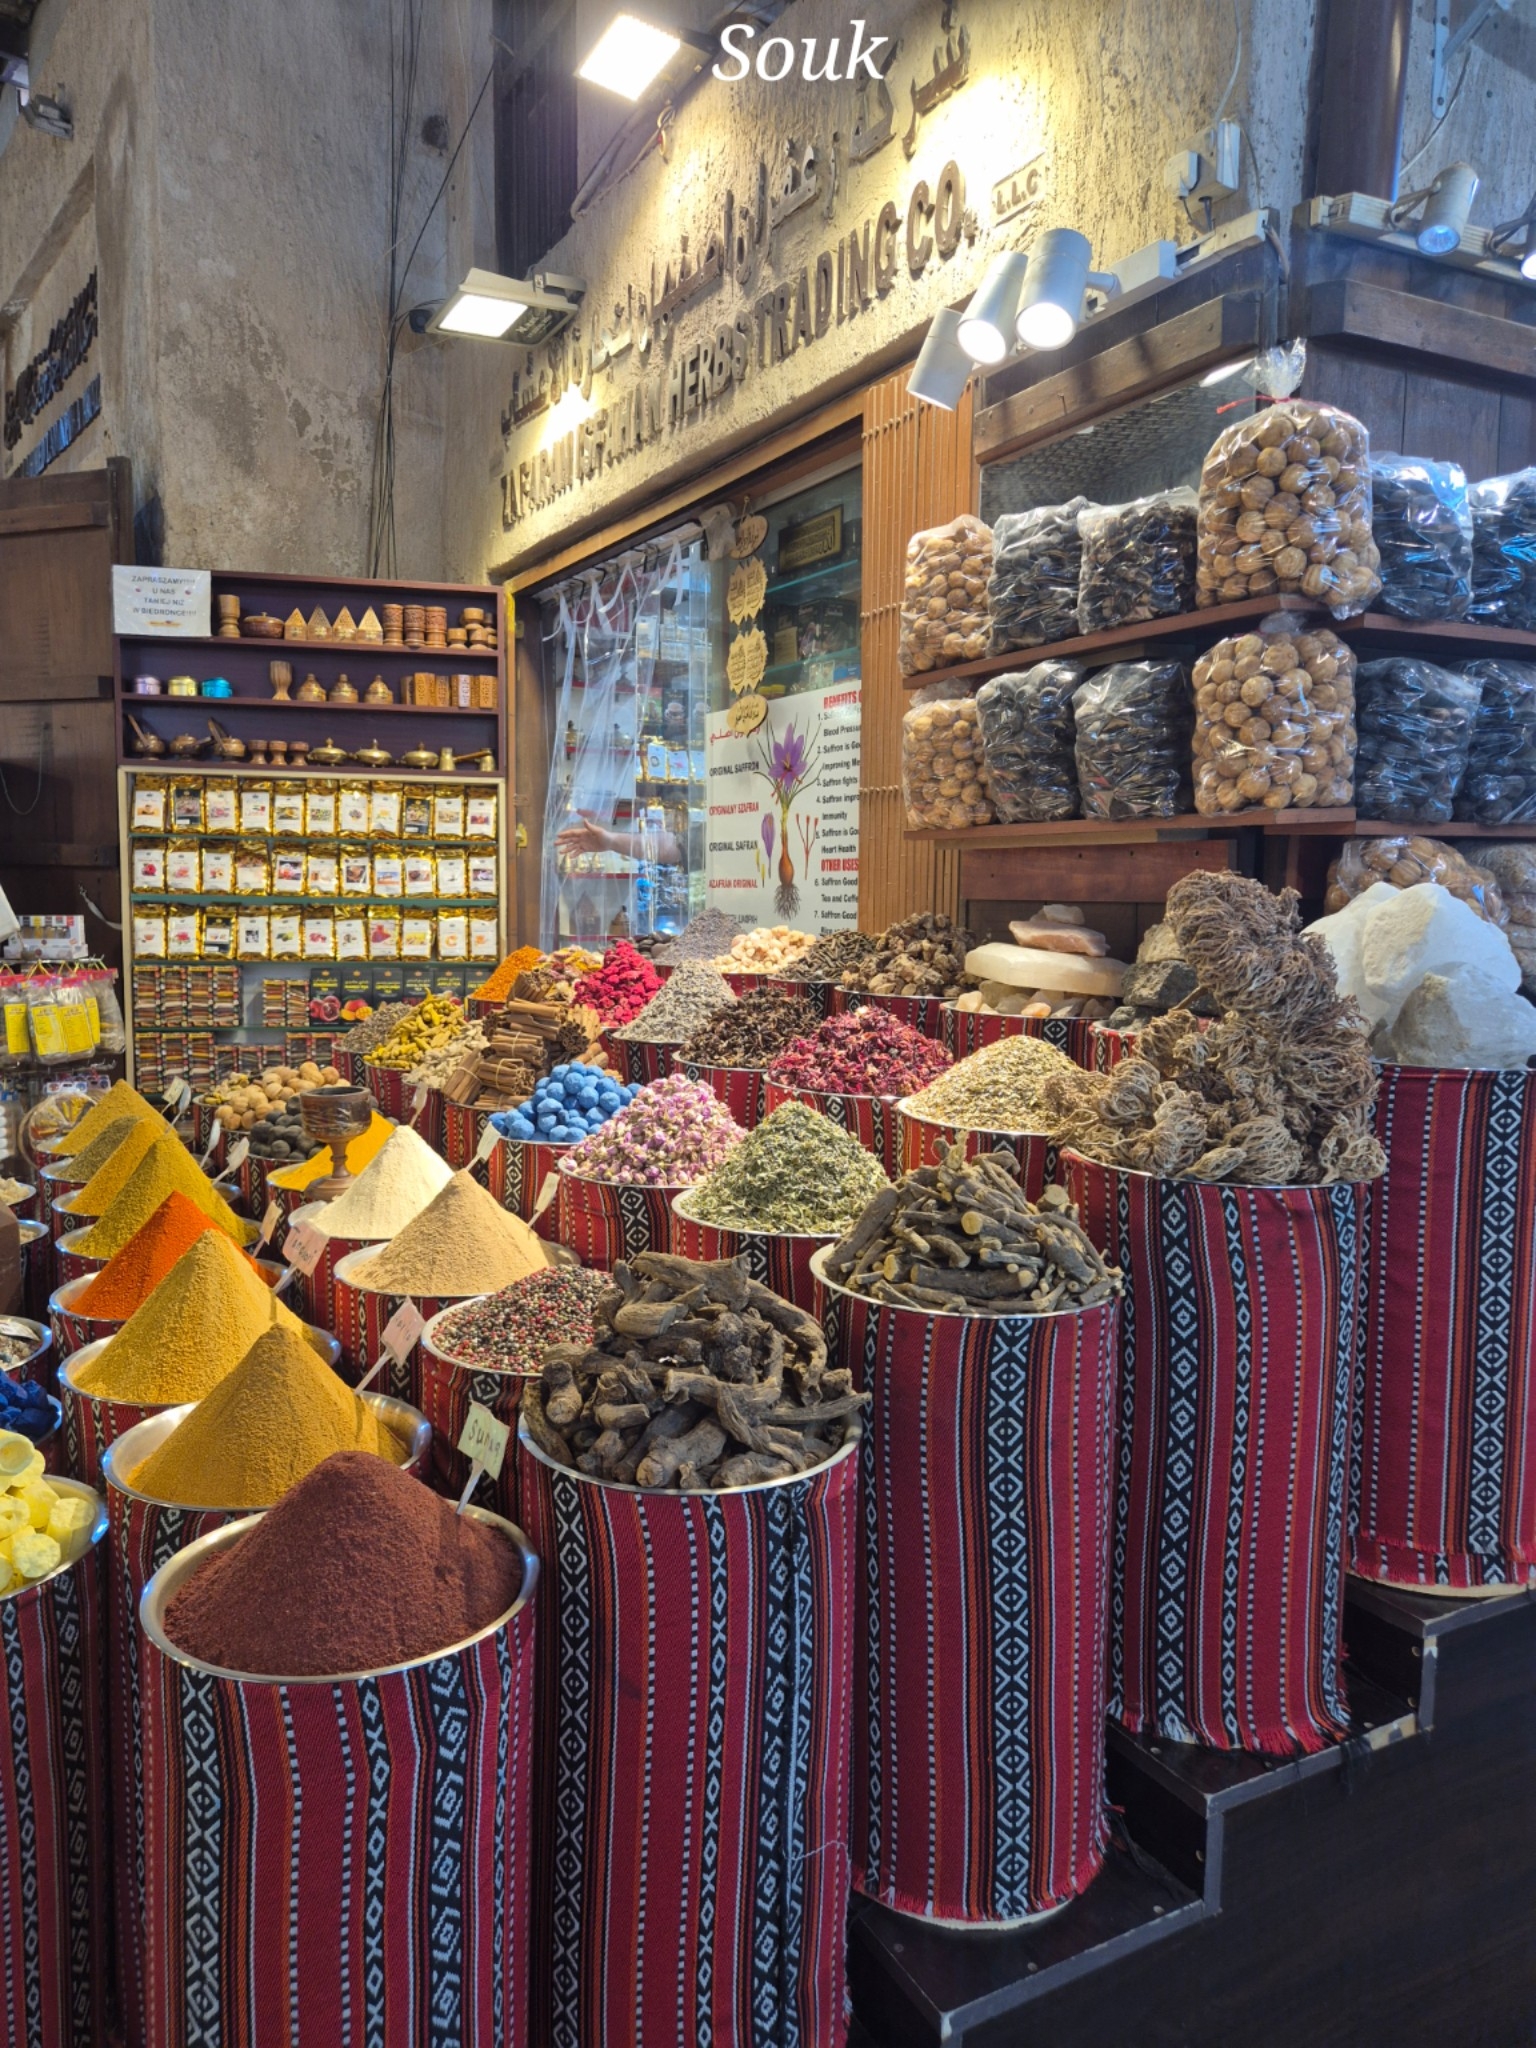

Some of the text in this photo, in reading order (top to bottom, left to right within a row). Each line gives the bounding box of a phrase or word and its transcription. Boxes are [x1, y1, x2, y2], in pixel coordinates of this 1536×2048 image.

[667, 310, 753, 424] HERBS
[754, 201, 899, 370] TRADING
[907, 160, 976, 273] CO.
[823, 691, 857, 709] BENEFITS
[709, 761, 759, 777] ORIGINAL SAFFRON
[823, 778, 841, 787] Saffron
[842, 776, 857, 787] fights
[822, 794, 842, 804] Saffron
[822, 811, 847, 820] Immunity
[822, 828, 841, 837] Saffron
[709, 841, 734, 852] ORIGINAL
[821, 844, 856, 854] Heart Health
[821, 859, 841, 871] OTHER
[733, 880, 758, 888] ORIGINAL
[821, 877, 841, 885] Saffron
[843, 877, 858, 886] Good
[821, 911, 841, 919] Saffron
[842, 911, 857, 919] Good
